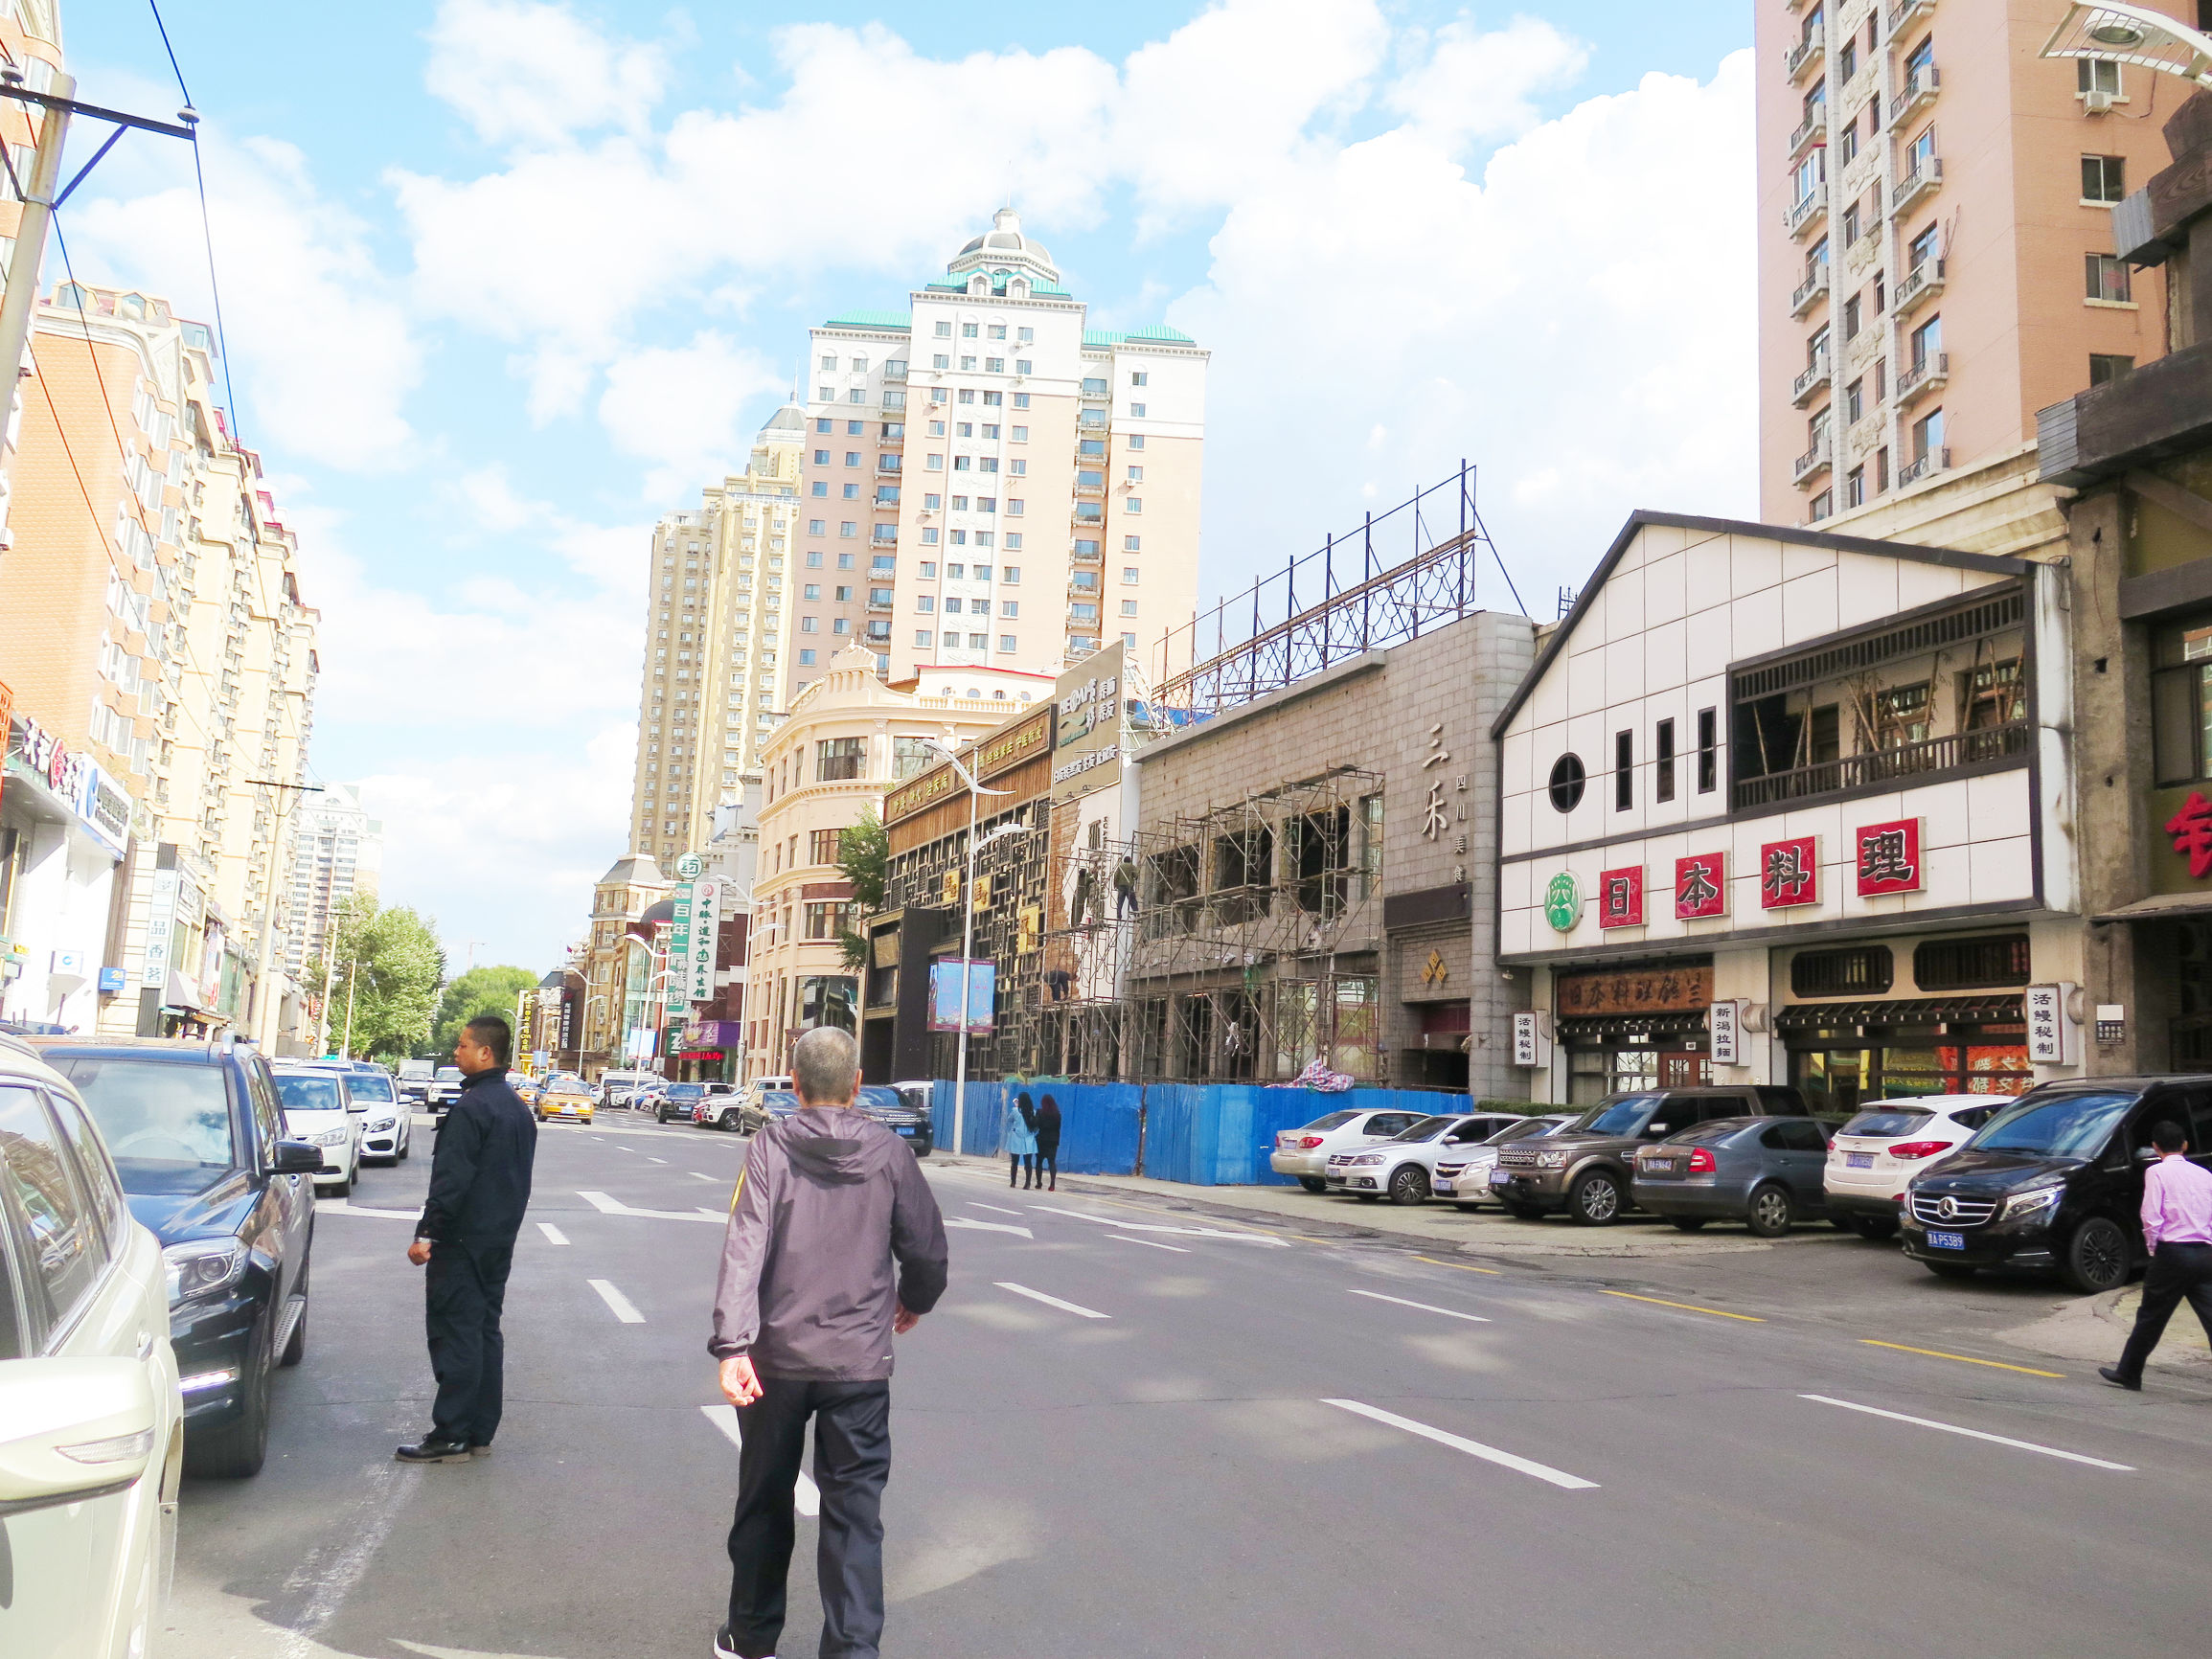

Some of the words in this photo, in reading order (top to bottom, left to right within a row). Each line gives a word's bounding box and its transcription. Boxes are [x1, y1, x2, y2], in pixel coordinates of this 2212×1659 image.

[1454, 773, 1468, 883] 四川美食
[1608, 828, 1914, 917] 日本料理
